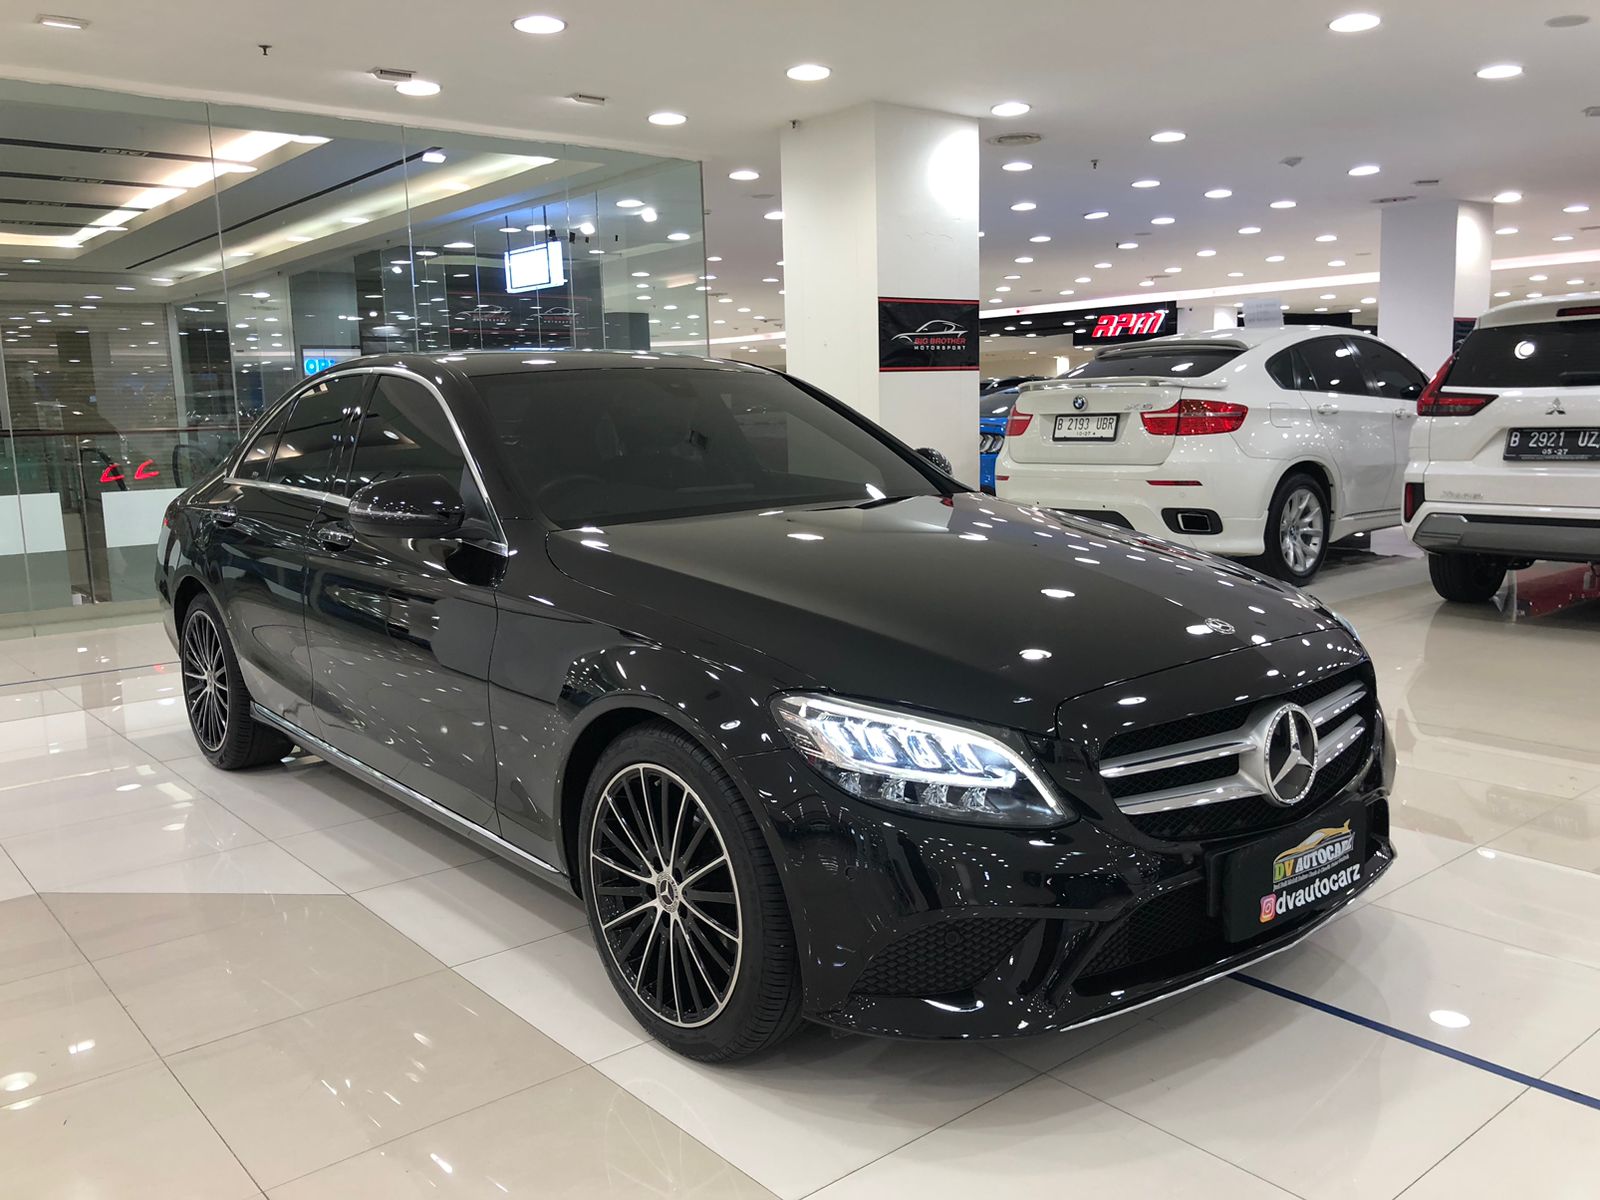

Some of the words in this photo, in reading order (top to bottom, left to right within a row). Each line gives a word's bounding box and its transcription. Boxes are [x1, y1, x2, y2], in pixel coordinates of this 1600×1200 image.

[1092, 312, 1165, 337] RPM
[914, 337, 928, 345] BIG
[930, 337, 966, 345] BROTHER
[1057, 418, 1064, 431] B
[1067, 418, 1090, 431] 2193
[1096, 417, 1114, 430] UBR
[1510, 431, 1520, 447] B
[1528, 431, 1565, 447] 2921
[1577, 431, 1600, 448] UZ
[1274, 859, 1294, 881] DV
[1276, 863, 1361, 915] dvautocarz
